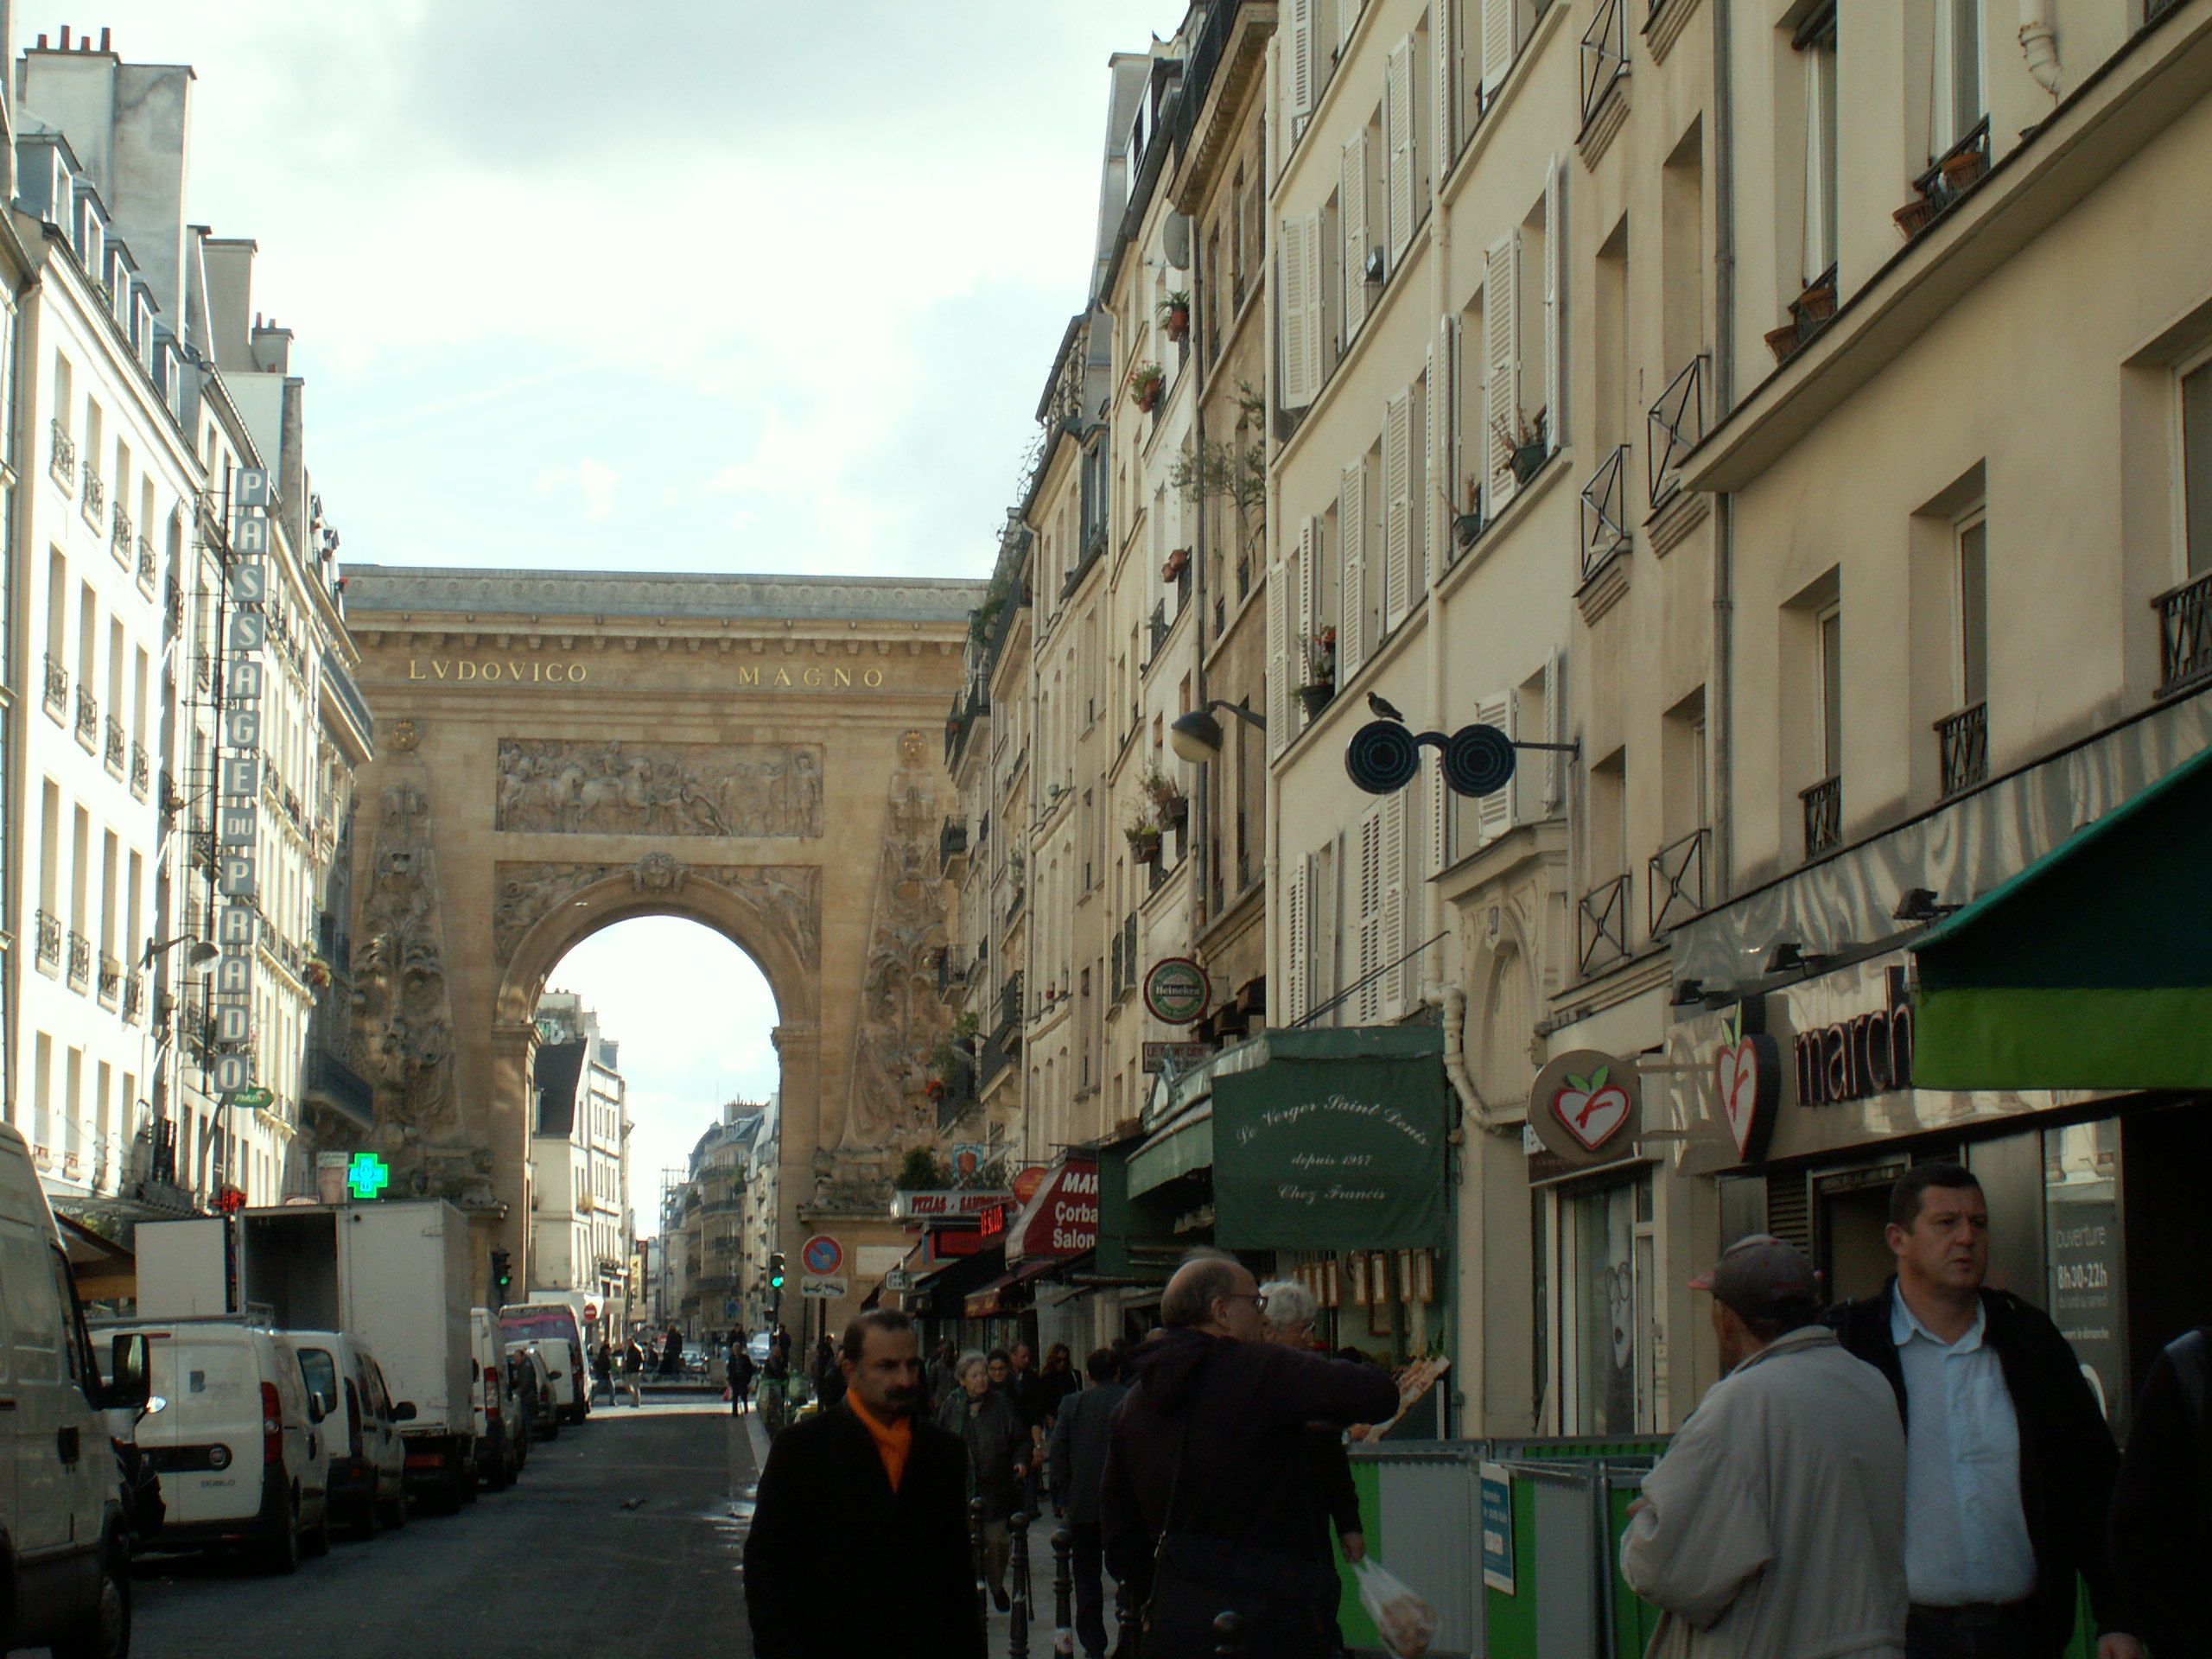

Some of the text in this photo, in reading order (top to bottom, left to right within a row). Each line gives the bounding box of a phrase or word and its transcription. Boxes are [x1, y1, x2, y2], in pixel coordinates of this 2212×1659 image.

[409, 658, 884, 689] LVDOVICO MAGNO
[219, 473, 261, 1090] PASSAGE DU PRADO
[1155, 985, 1200, 995] Heineken
[1261, 1103, 1318, 1127] Verger
[1324, 1093, 1381, 1116] Saint
[1382, 1108, 1429, 1147] Denis
[1291, 1152, 1336, 1170] depuis
[912, 1196, 947, 1213] PIZZAS
[1277, 1184, 1386, 1205] Chez Francis
[1054, 1201, 1098, 1226] Çorba
[1052, 1227, 1096, 1249] Salon
[2056, 1224, 2107, 1248] ouverture
[2057, 1262, 2108, 1288] 8h30-22h
